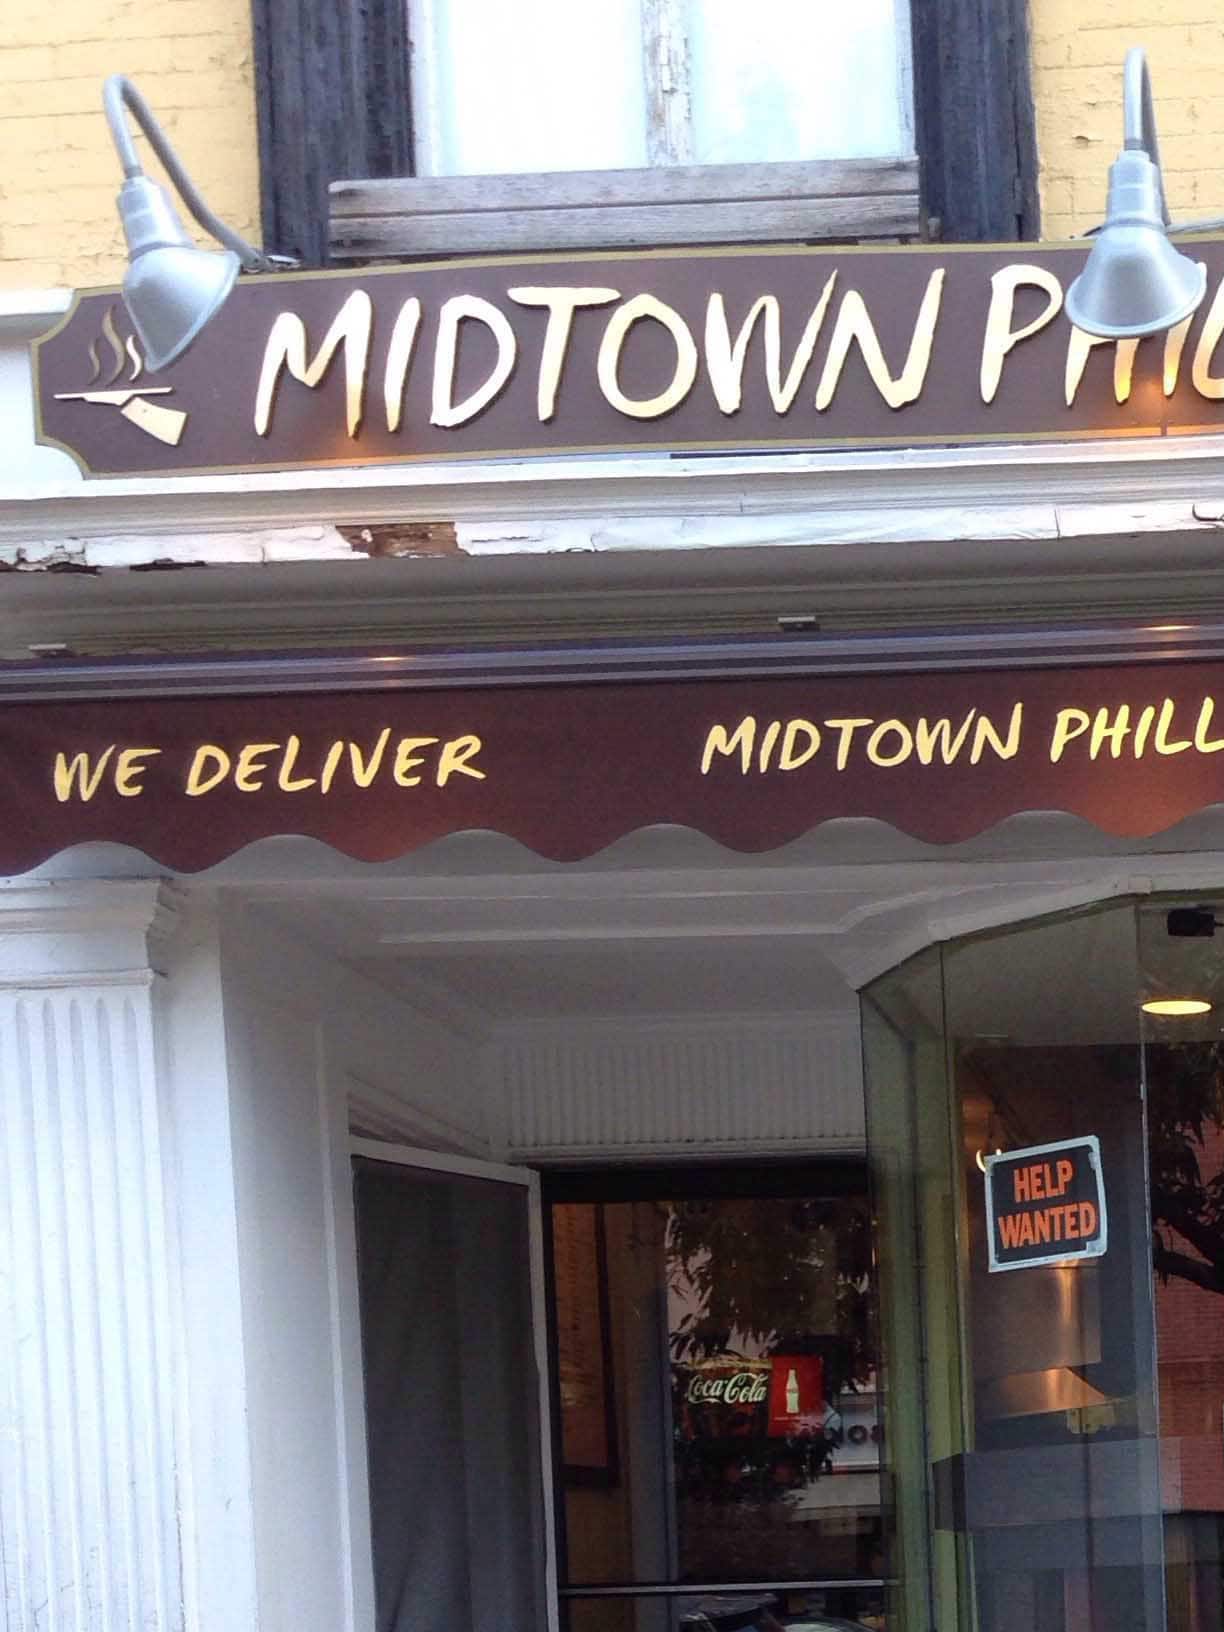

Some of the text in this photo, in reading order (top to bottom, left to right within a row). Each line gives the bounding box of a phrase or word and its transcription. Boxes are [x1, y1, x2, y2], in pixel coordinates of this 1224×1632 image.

[254, 266, 945, 437] MIDTOWN
[53, 728, 488, 802] WE DELIVER
[700, 702, 1023, 776] MIDTOWN
[1013, 1159, 1074, 1203] HELP
[998, 1201, 1097, 1249] WANTED
[688, 1372, 769, 1404] Coca-Cola
